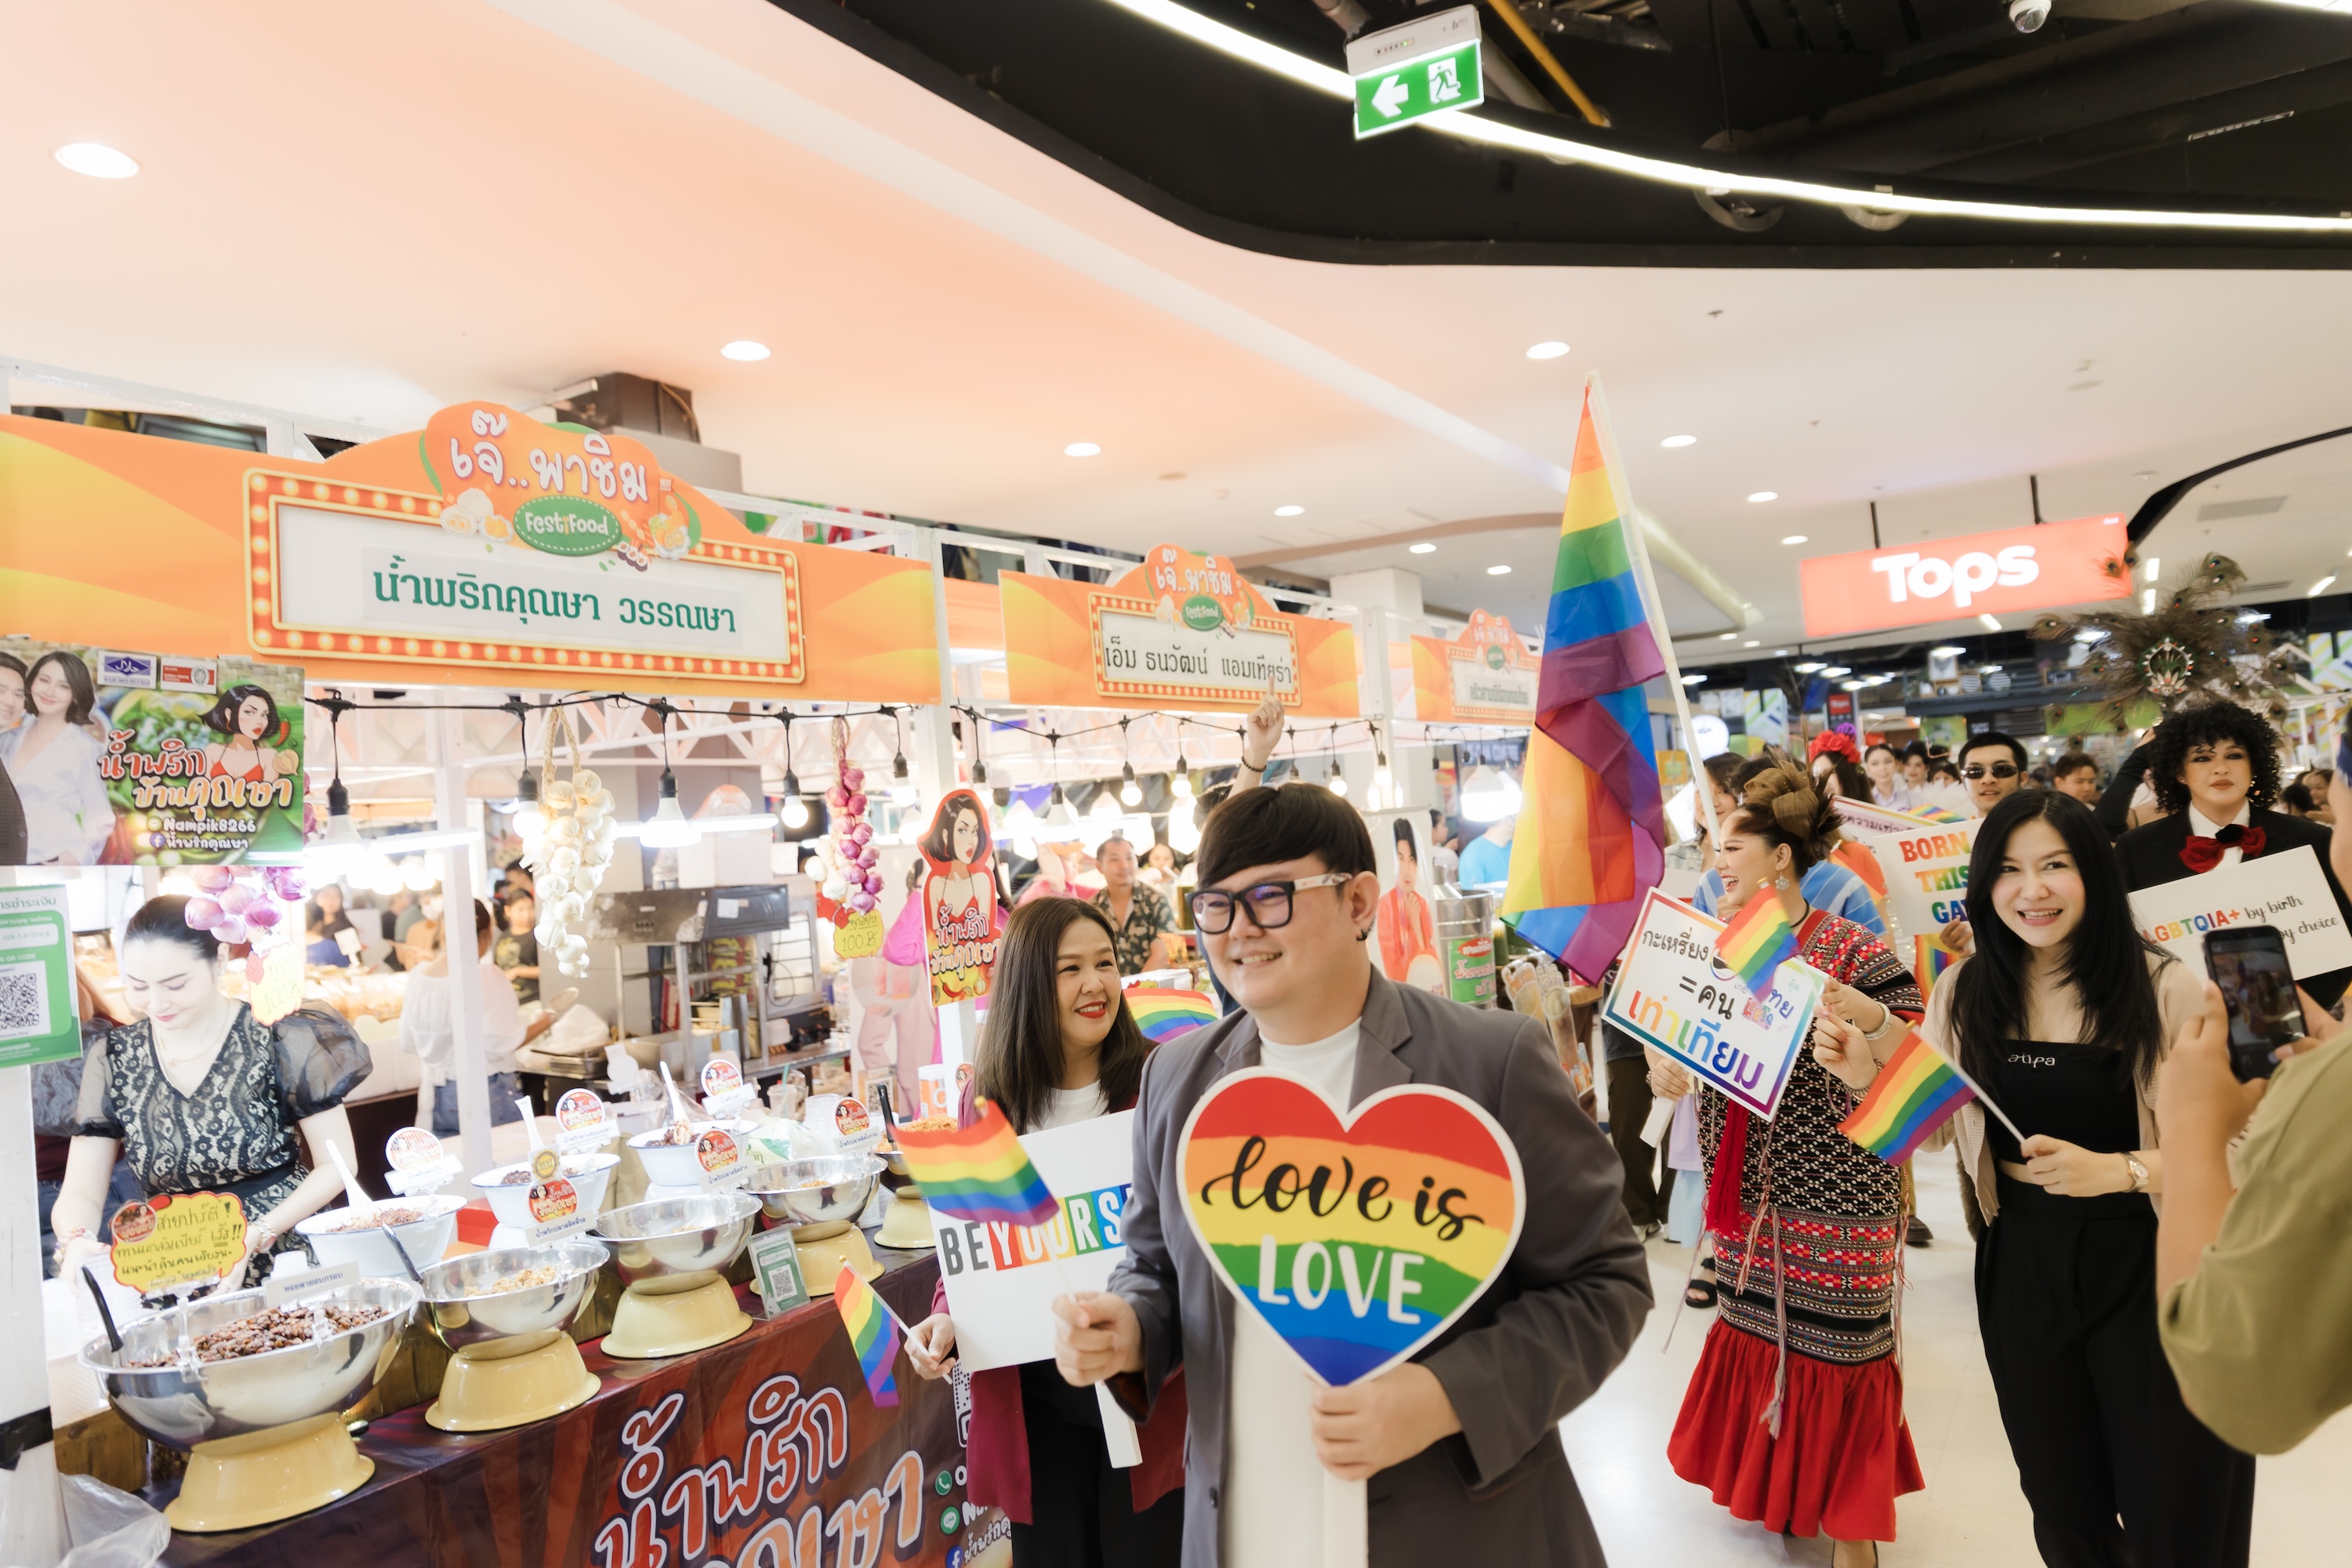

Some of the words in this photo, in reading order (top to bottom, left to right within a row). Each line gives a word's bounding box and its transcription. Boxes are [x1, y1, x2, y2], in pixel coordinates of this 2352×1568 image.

[372, 554, 601, 624] น้ำพริกคุณษา
[619, 597, 737, 633] วรรณษา
[1872, 545, 2040, 608] Tops
[1105, 635, 1137, 669] เอ็ม
[1145, 644, 1208, 675] ธนวัฒน์
[97, 728, 207, 780] น้ำพริก
[132, 774, 293, 821] บ้านคุณษา
[163, 818, 256, 834] Nampik8266
[1899, 831, 1972, 862] BORN
[1915, 866, 1969, 893] THIS
[842, 934, 863, 952] 100
[936, 904, 989, 947] น้ำพริก
[2143, 909, 2241, 944] LGBTQIA+
[2244, 907, 2266, 924] by
[2266, 895, 2304, 914] birth
[2299, 917, 2340, 934] choice
[1642, 927, 1709, 962] กะเหรี่ยง
[1769, 989, 1795, 1019] ทย
[1698, 985, 1735, 1020] คน
[1628, 989, 1765, 1090] เท่าเทียม
[1201, 1136, 1393, 1221] love
[1414, 1176, 1485, 1241] is
[1258, 1234, 1425, 1325] LOVE
[594, 1374, 848, 1568] น้ำพริก
